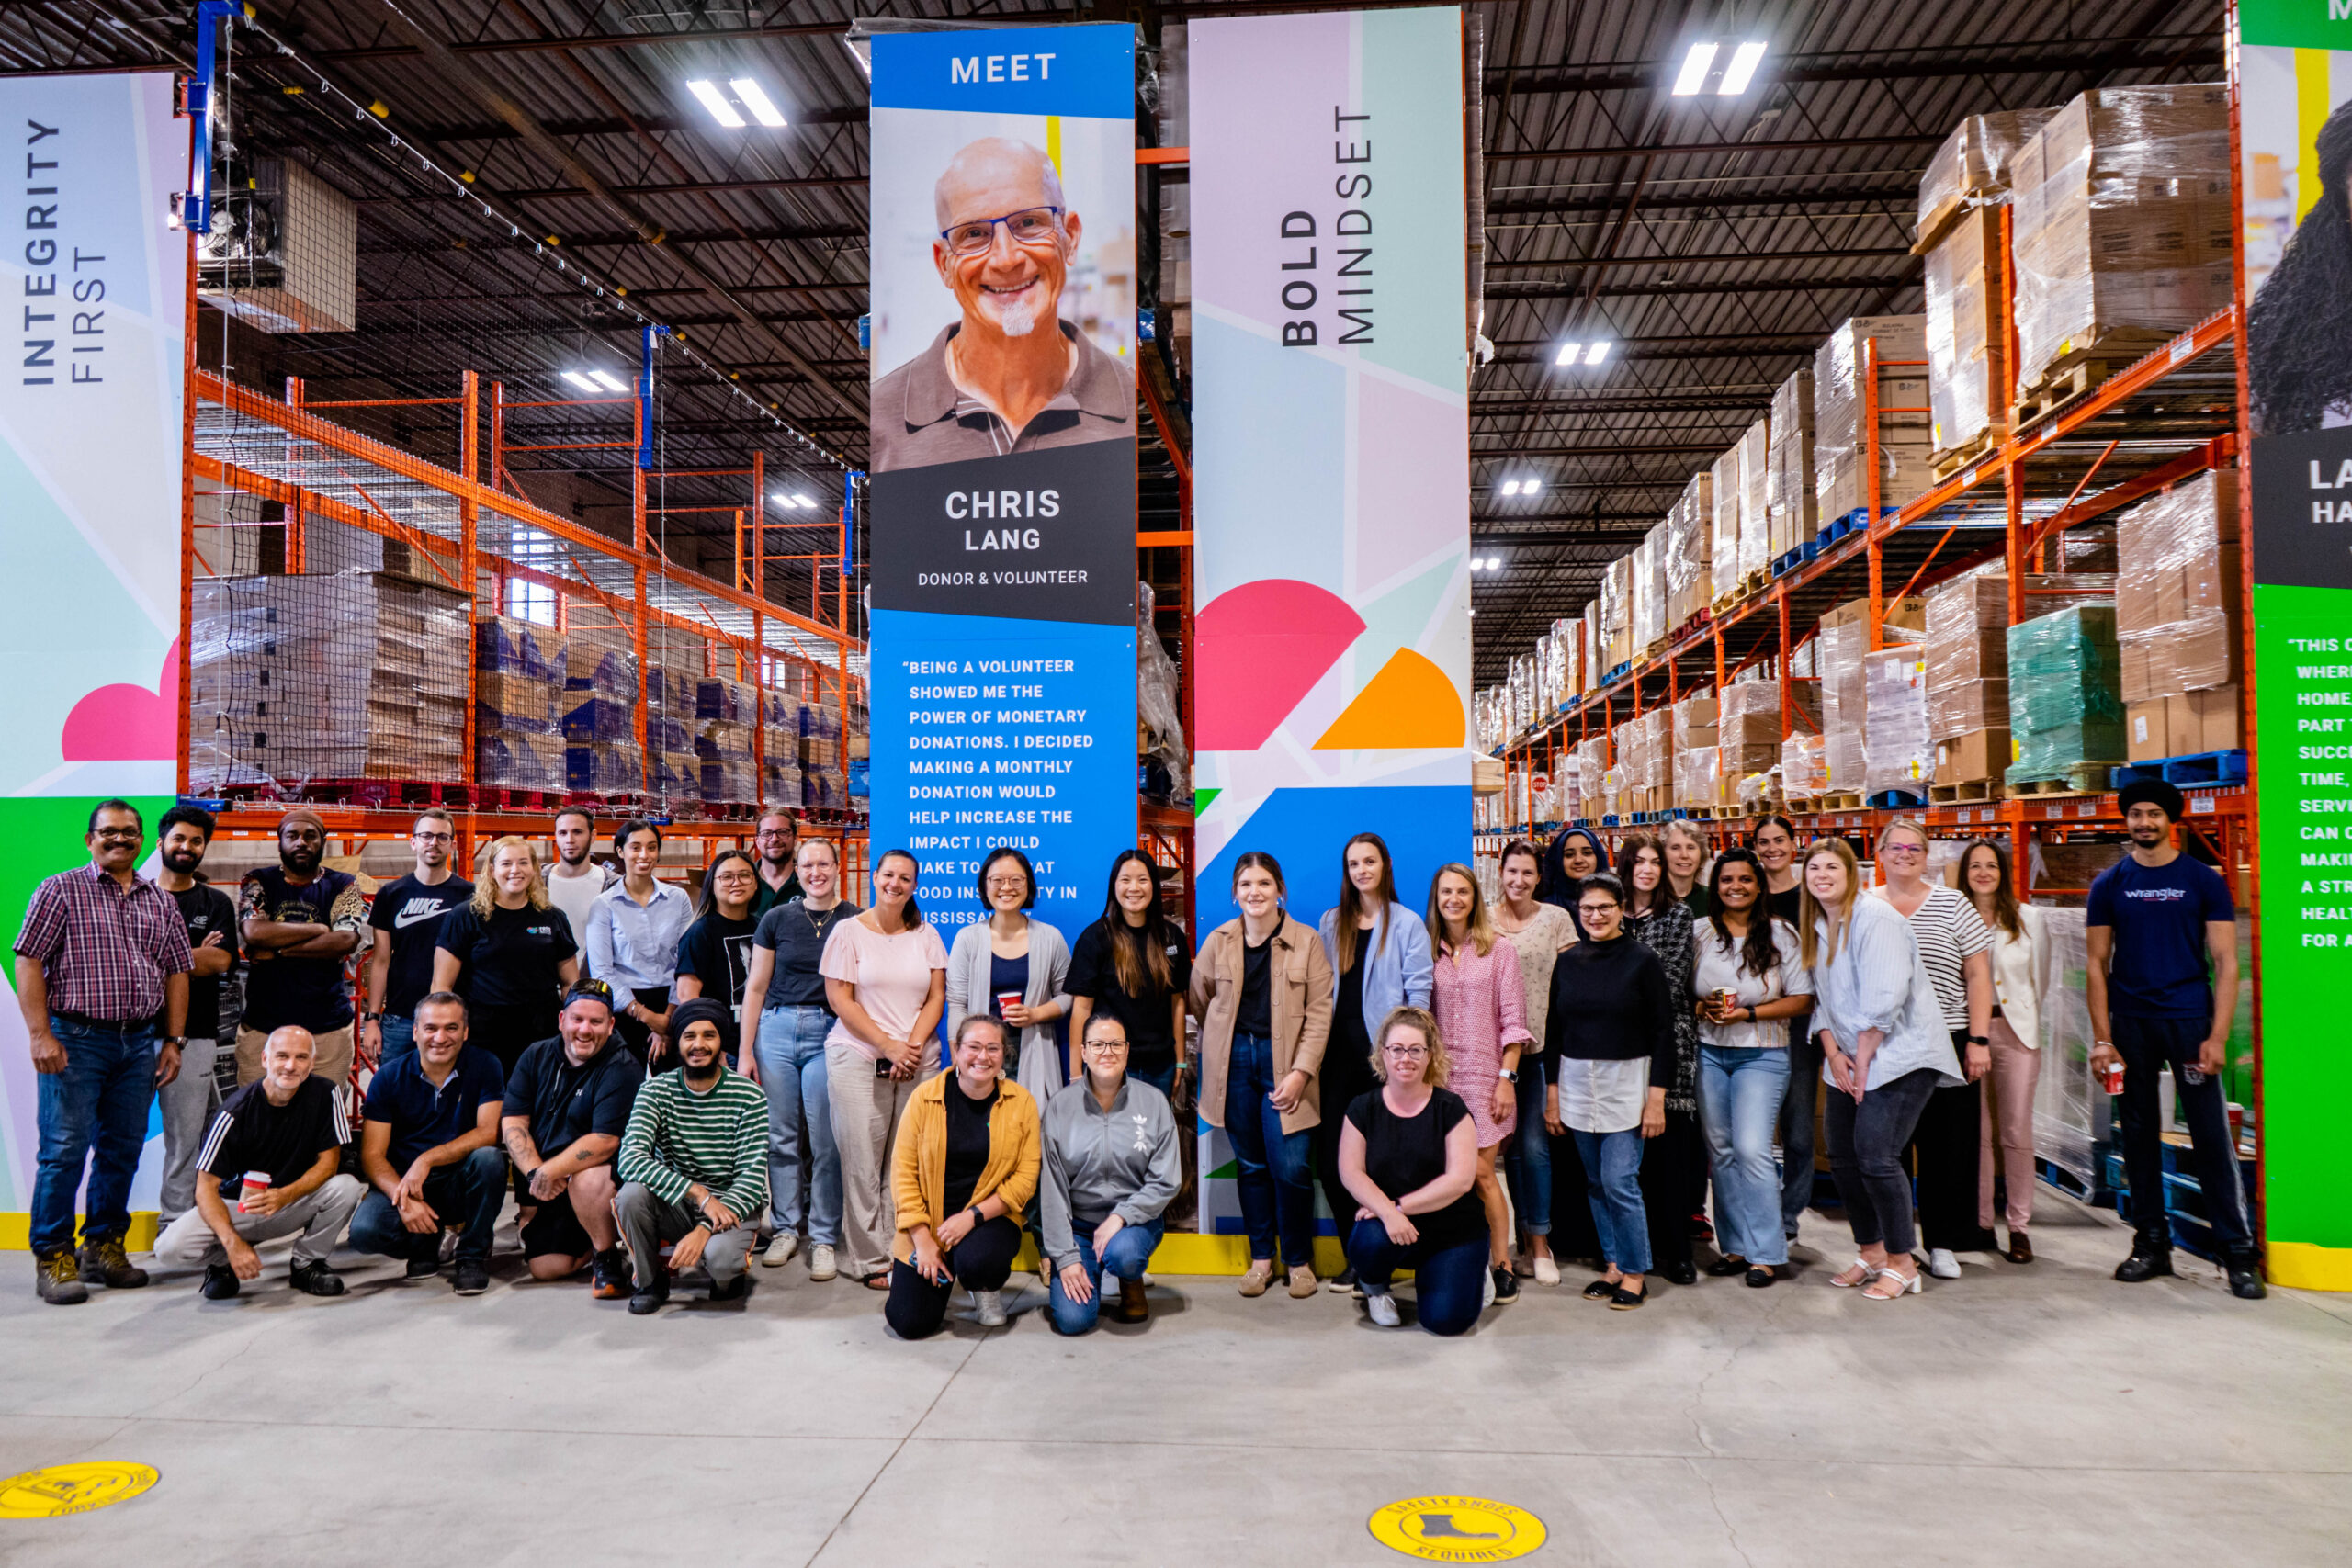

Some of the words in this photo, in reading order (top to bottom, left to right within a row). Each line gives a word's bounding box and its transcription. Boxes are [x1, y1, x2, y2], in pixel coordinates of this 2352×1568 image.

[952, 53, 1056, 84] MEET
[1335, 106, 1373, 344] MINDSET
[24, 119, 59, 384] INTEGRITY
[1282, 211, 1317, 346] BOLD
[73, 247, 105, 382] FIRST
[946, 490, 1059, 519] CHRIS
[966, 529, 1039, 550] LANG
[919, 573, 973, 585] DONOR
[979, 572, 988, 584] &
[994, 570, 1087, 584] VOLUNTEER
[903, 661, 957, 673] “BEING
[963, 661, 973, 673] A
[979, 660, 1073, 672] VOLUNTEER
[2297, 666, 2352, 679] WHER
[910, 686, 977, 699] SHOWED
[984, 686, 1006, 698] ME
[1012, 685, 1042, 697] THE
[910, 711, 966, 724] POWER
[971, 711, 991, 723] OF
[998, 710, 1086, 723] MONETARY
[2299, 719, 2346, 732] PART
[910, 736, 1008, 749] DONATIONS.
[1015, 736, 1018, 748] I
[1025, 735, 1092, 748] DECIDED
[910, 761, 973, 773] MAKING
[979, 761, 989, 773] A
[996, 761, 1072, 773] MONTHLY
[2299, 773, 2350, 787] TIME,
[910, 786, 992, 798] DONATION
[999, 785, 1055, 798] WOULD
[910, 811, 950, 823] HELP
[956, 811, 1035, 823] INCREASE
[1041, 811, 1072, 823] THE
[2301, 827, 2339, 840] CAN
[910, 837, 970, 849] IMPACT
[977, 837, 979, 848] I
[987, 836, 1039, 848] COULD
[959, 862, 980, 874] TO
[1059, 886, 1077, 898] IN
[2125, 887, 2186, 901] wrangler
[2301, 881, 2314, 893] A
[402, 898, 444, 916] NIKE
[2303, 934, 2338, 947] FOR
[1386, 1497, 1451, 1515] SAFETY
[1459, 1498, 1519, 1516] SHOES
[1414, 1546, 1514, 1562] REQUIRED
